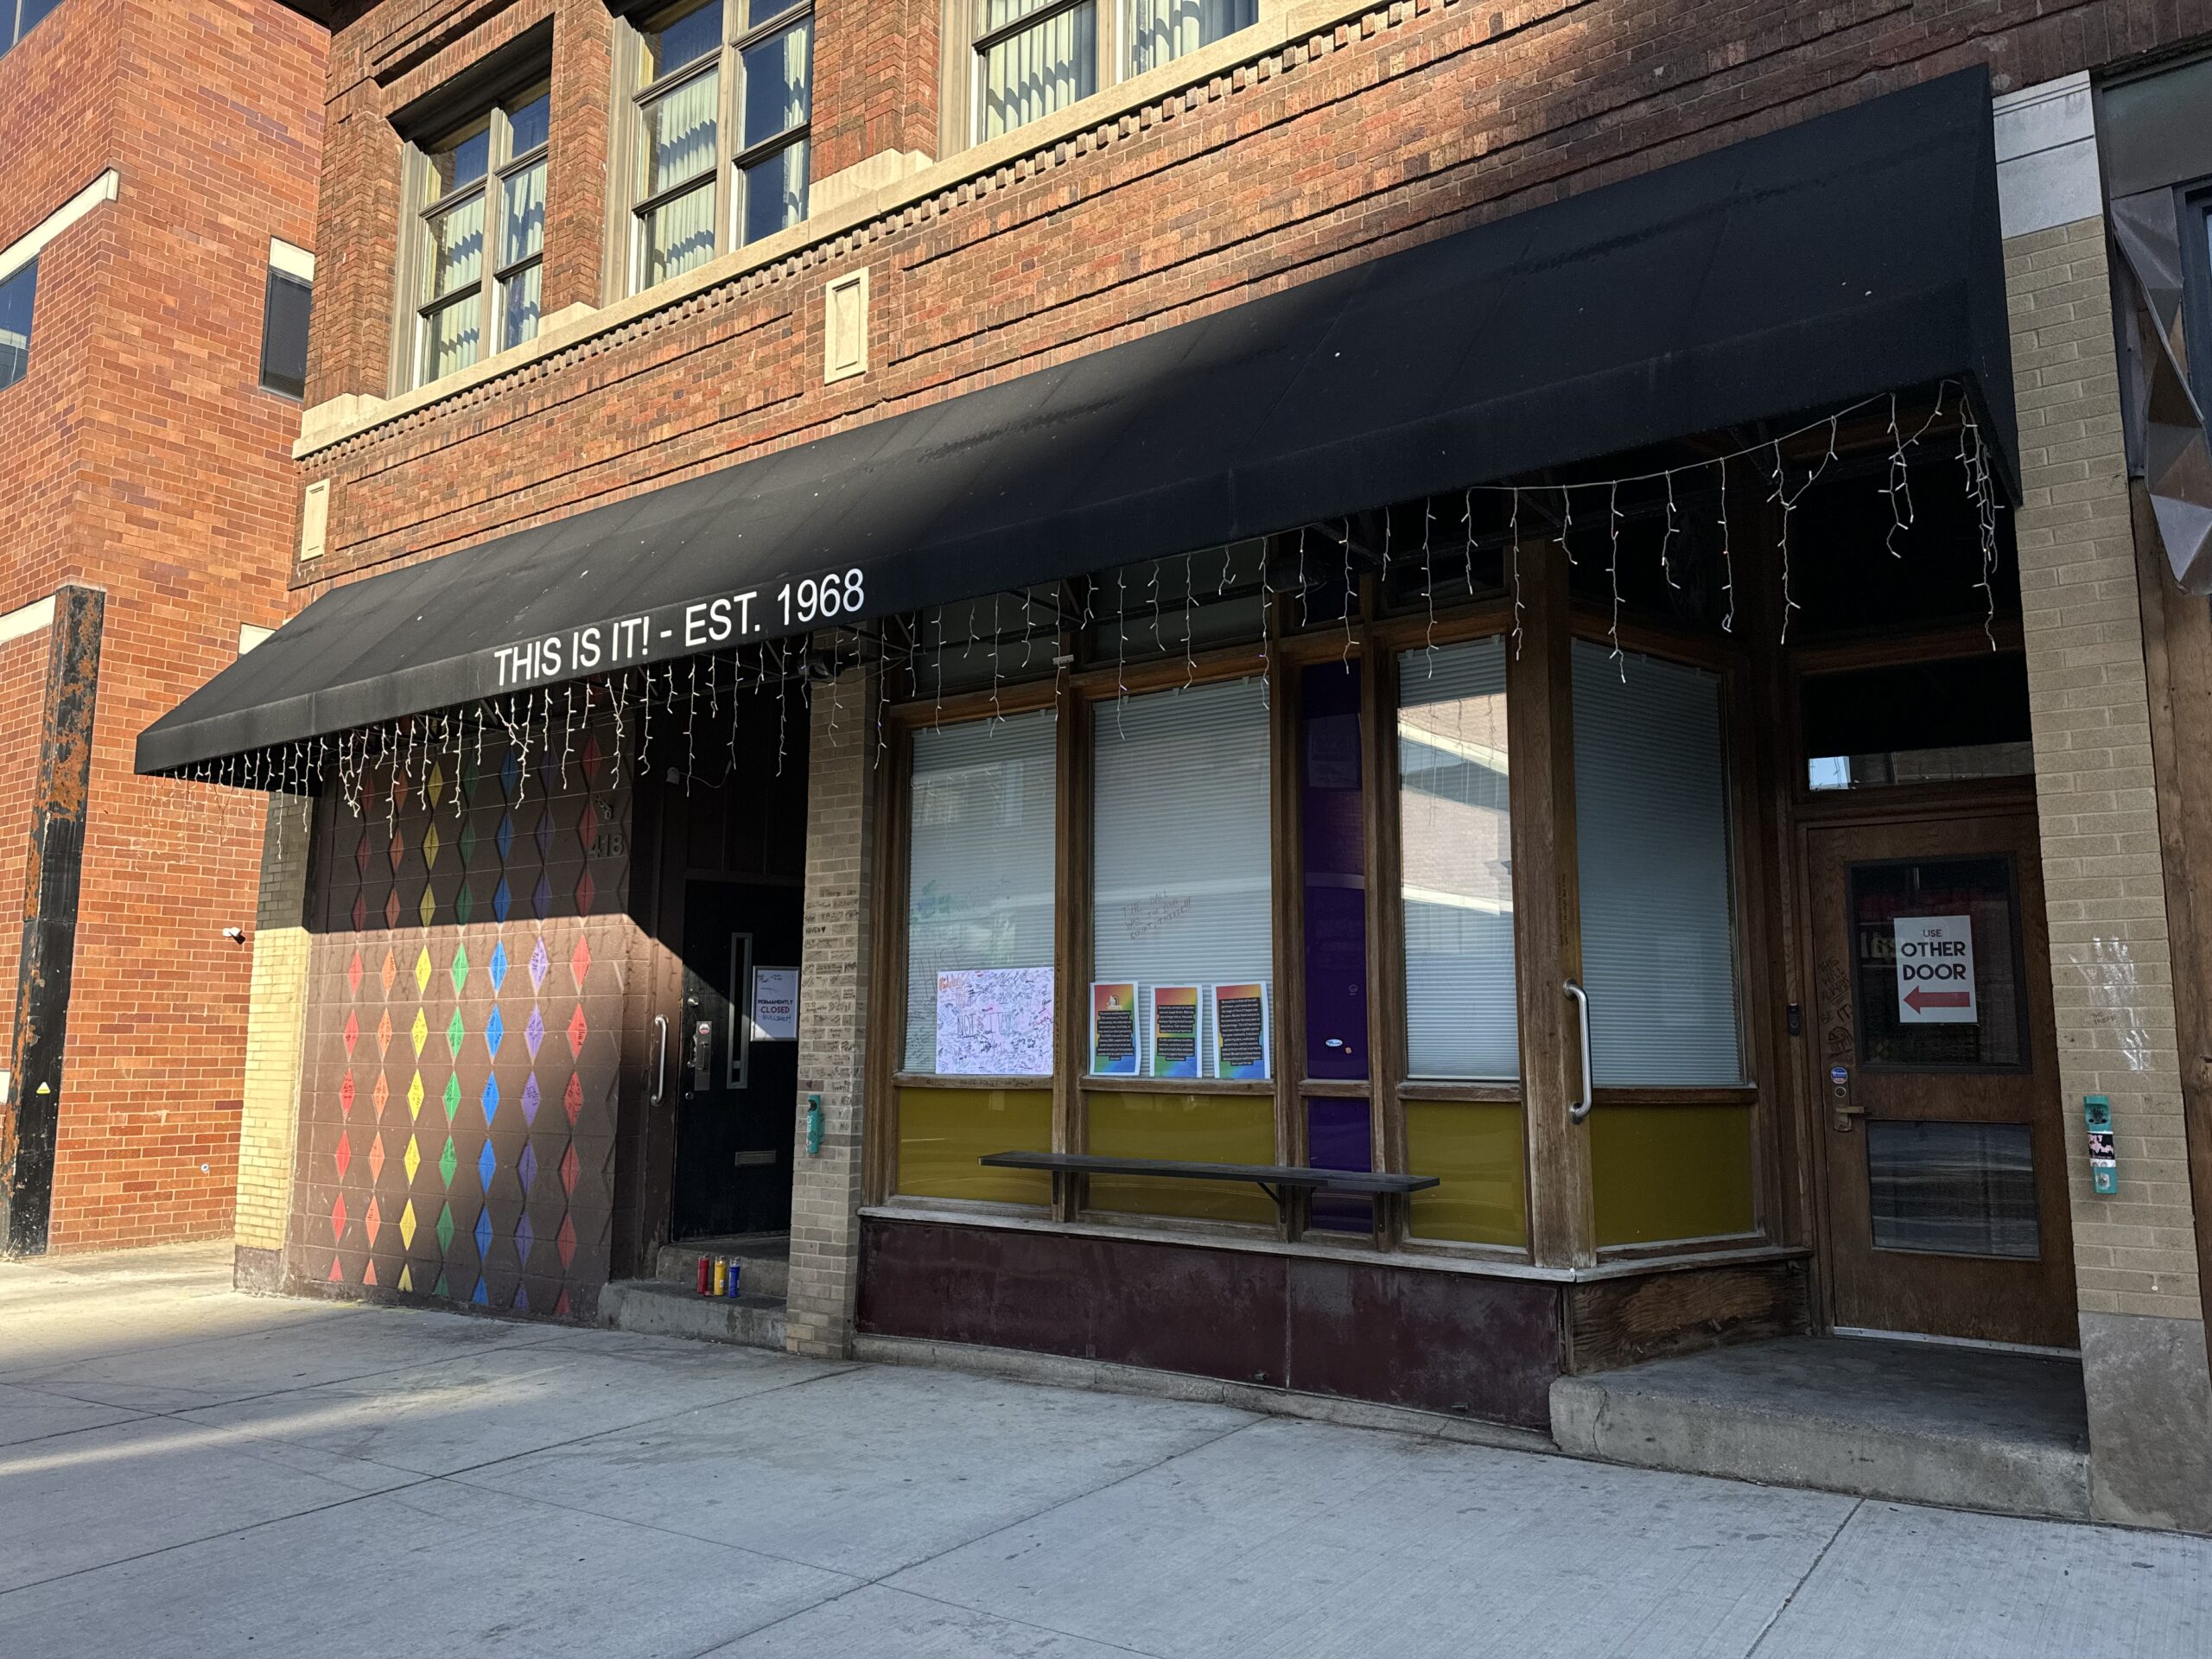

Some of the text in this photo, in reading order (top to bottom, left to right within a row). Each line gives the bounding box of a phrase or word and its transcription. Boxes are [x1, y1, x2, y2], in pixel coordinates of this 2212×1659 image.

[494, 568, 865, 686] THIS IS IT! - EST. 1968
[1923, 929, 1942, 938] USE
[1901, 941, 1966, 957] OTHER
[1903, 963, 1967, 981] DOOR
